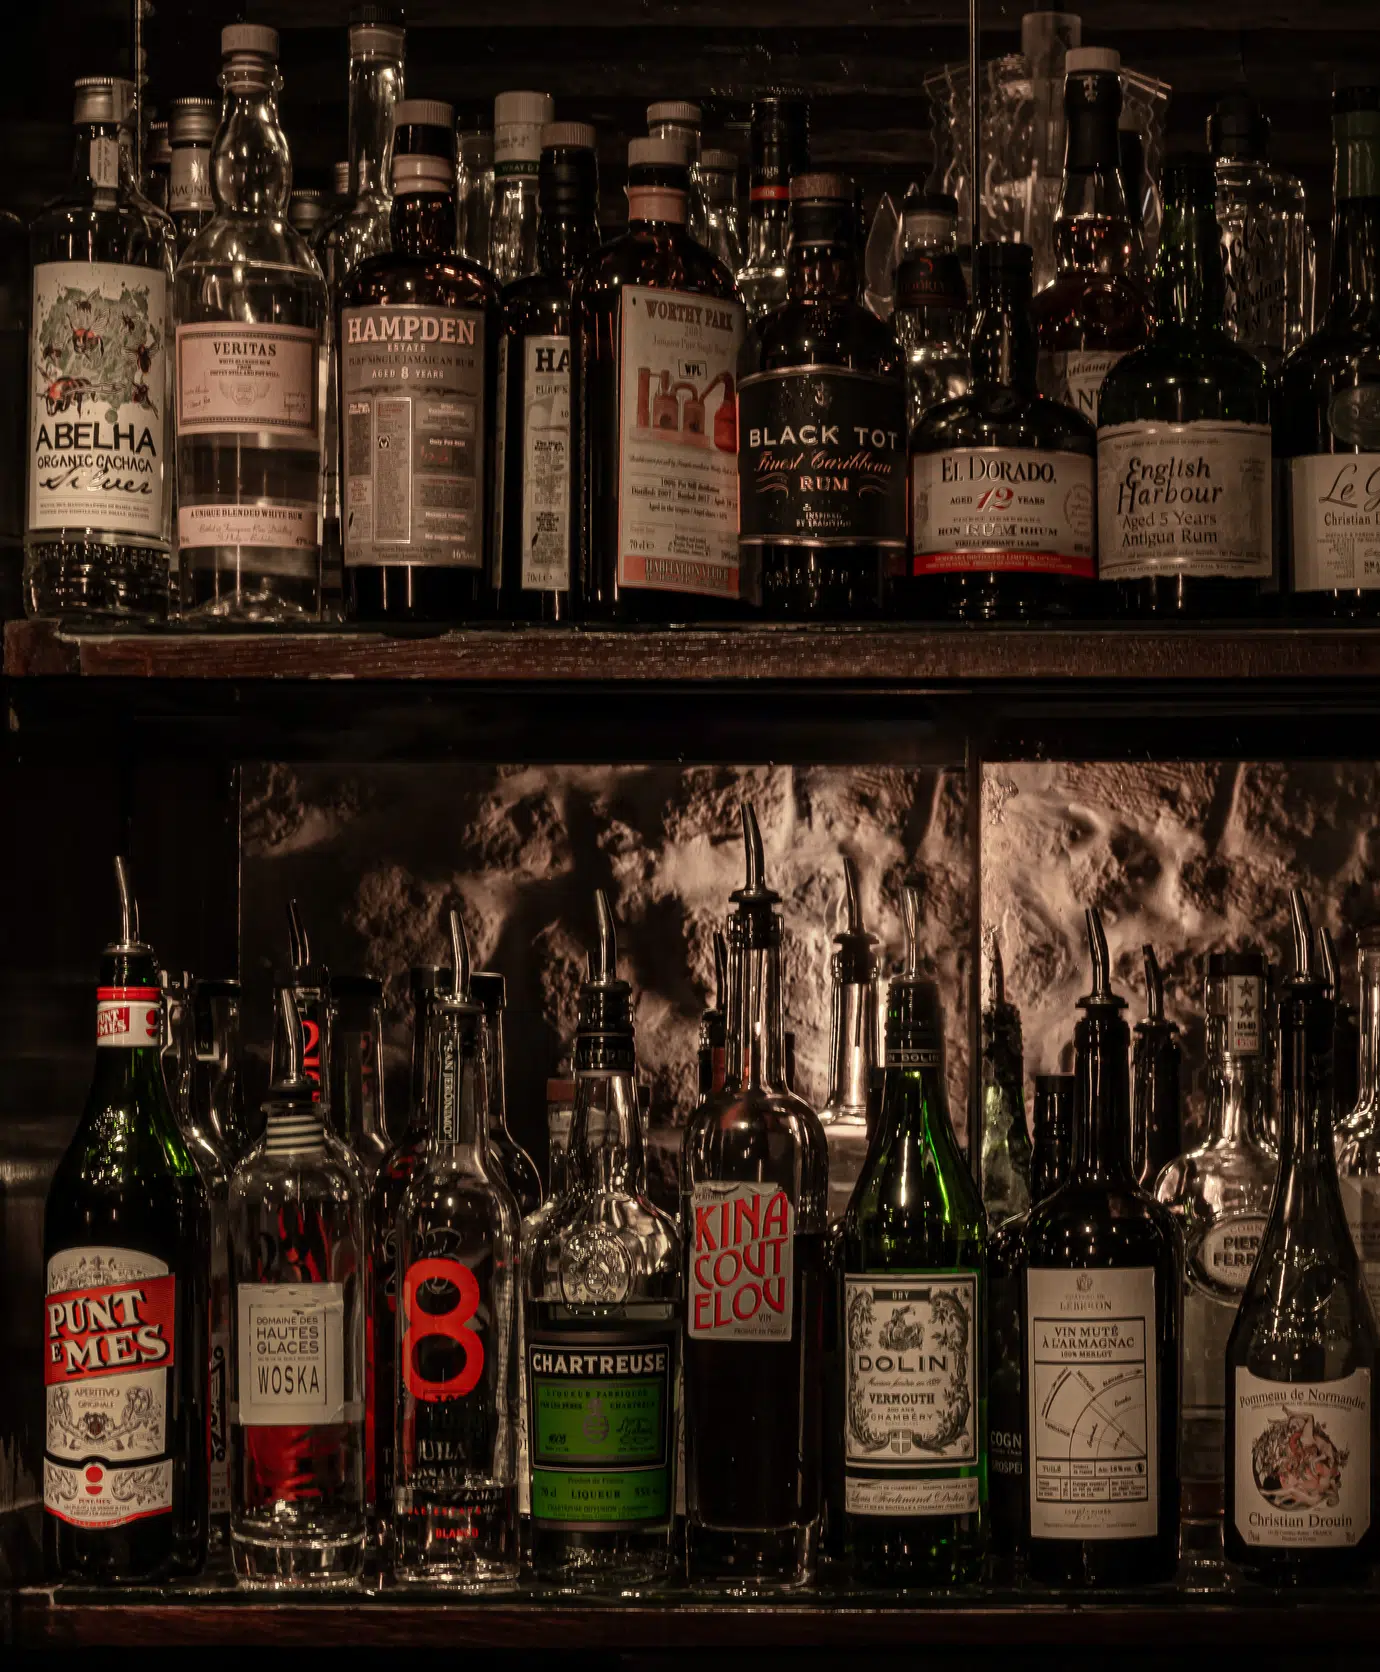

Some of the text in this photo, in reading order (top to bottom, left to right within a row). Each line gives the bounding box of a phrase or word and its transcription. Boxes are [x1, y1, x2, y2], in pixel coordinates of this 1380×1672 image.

[645, 299, 733, 333] WORTHY PARK
[347, 315, 476, 346] HAMPDEN
[213, 342, 277, 357] VERITAS
[387, 342, 426, 353] ESTATE
[403, 355, 452, 366] JAMAICAN
[371, 366, 445, 380] AGED 8 YEARS
[36, 422, 156, 457] ABELHA
[749, 424, 899, 450] BLACK TOT
[38, 454, 93, 470] ORGANIC
[1126, 456, 1211, 490] English
[800, 475, 849, 492] RUM
[1319, 463, 1358, 509] Le
[950, 486, 1046, 513] AGED 12 YEARS
[1117, 479, 1223, 515] Harbour
[195, 509, 220, 518] UNIQUE
[222, 509, 260, 518] BLENDED
[262, 510, 287, 519] WHITE
[1122, 510, 1217, 532] Aged 5 Years
[1324, 511, 1371, 527] Christian
[938, 522, 1058, 538] RON RUM RHUM
[1122, 529, 1218, 548] Antigua Rum
[695, 1190, 789, 1252] KINA
[694, 1237, 789, 1290] COUT
[892, 1290, 910, 1300] DRY
[48, 1288, 146, 1338] PUNT
[256, 1316, 319, 1325] DOMAINE DES
[758, 1313, 772, 1323] VIN
[256, 1326, 319, 1340] HAUTES
[401, 1257, 485, 1404] 8
[1055, 1324, 1119, 1337] VIN MUTÉ
[64, 1324, 169, 1374] MES
[256, 1340, 319, 1355] GLACES
[1052, 1336, 1135, 1349] L'ARMAGNAC
[1061, 1350, 1113, 1358] 100% MERLOT
[532, 1352, 666, 1375] CHARTREUSE
[858, 1355, 949, 1373] DOLIN
[257, 1364, 320, 1395] WOSKA
[74, 1387, 121, 1398] APERITIVO
[546, 1389, 591, 1398] LIQUEUR
[868, 1392, 935, 1405] VERMOUTH
[1239, 1390, 1288, 1409] Pommeau
[1290, 1387, 1304, 1400] de
[1308, 1388, 1366, 1411] Normandie
[571, 1489, 621, 1501] LIQUEUR
[1248, 1511, 1353, 1528] Christian Drouin
